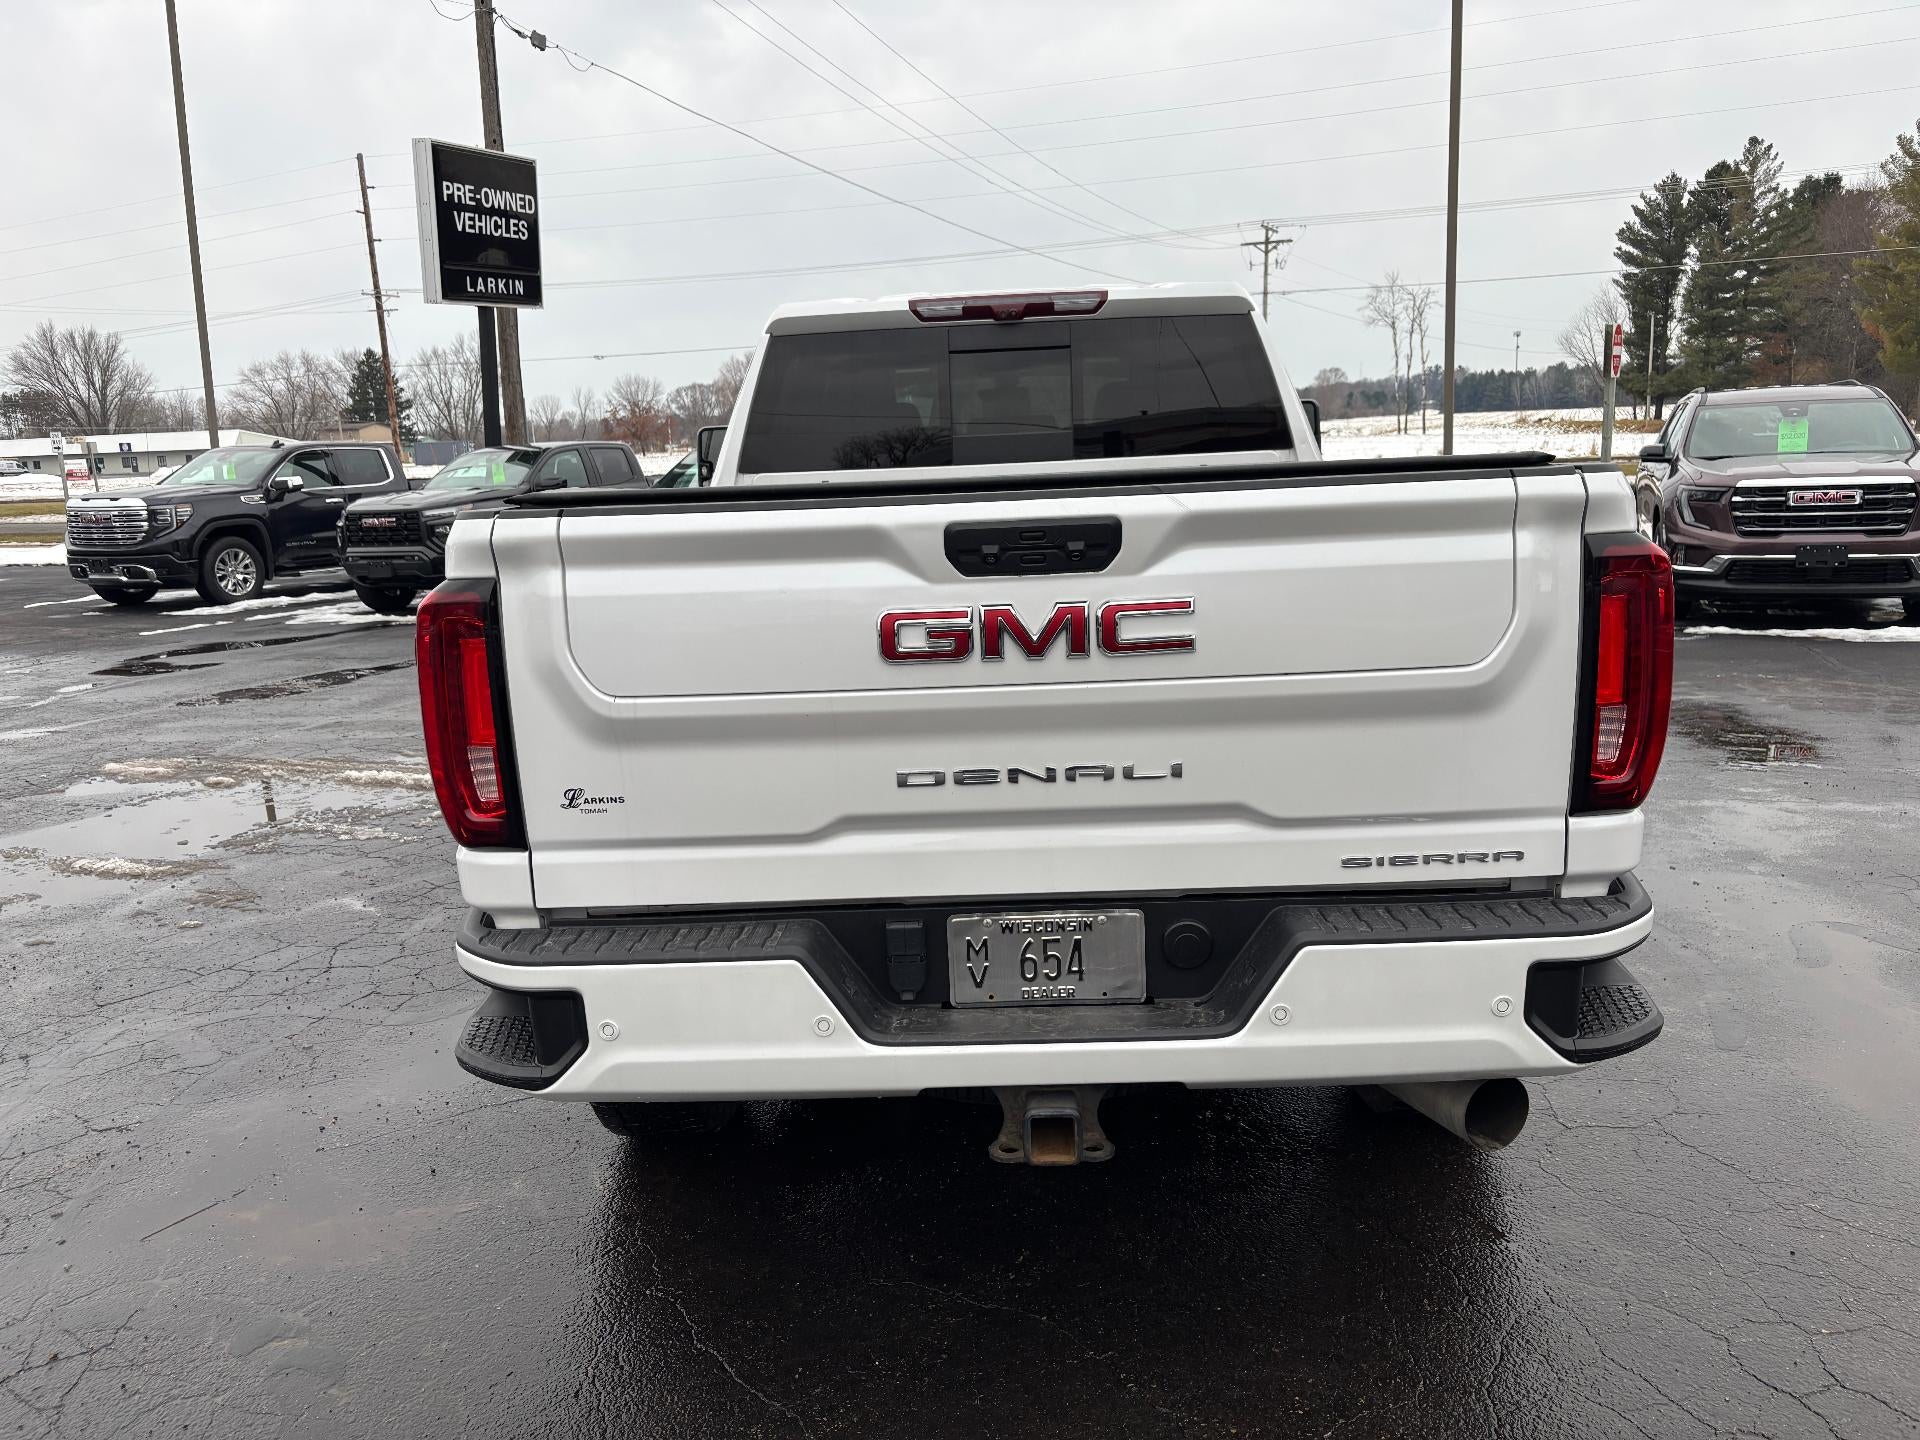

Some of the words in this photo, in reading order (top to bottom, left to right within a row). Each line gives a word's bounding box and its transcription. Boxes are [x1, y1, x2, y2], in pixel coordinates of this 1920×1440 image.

[442, 180, 535, 215] PRE-OWNED
[453, 210, 529, 241] VEHICLES
[466, 275, 525, 296] LARKIN
[1794, 491, 1857, 504] GMC
[361, 517, 396, 528] GMC
[876, 595, 1197, 665] GMC
[895, 760, 1184, 788] DENALI
[1340, 850, 1526, 869] SIERRA
[998, 917, 1094, 935] WISCONSIN
[1019, 935, 1086, 983] 654
[1020, 985, 1076, 1000] DEALER
